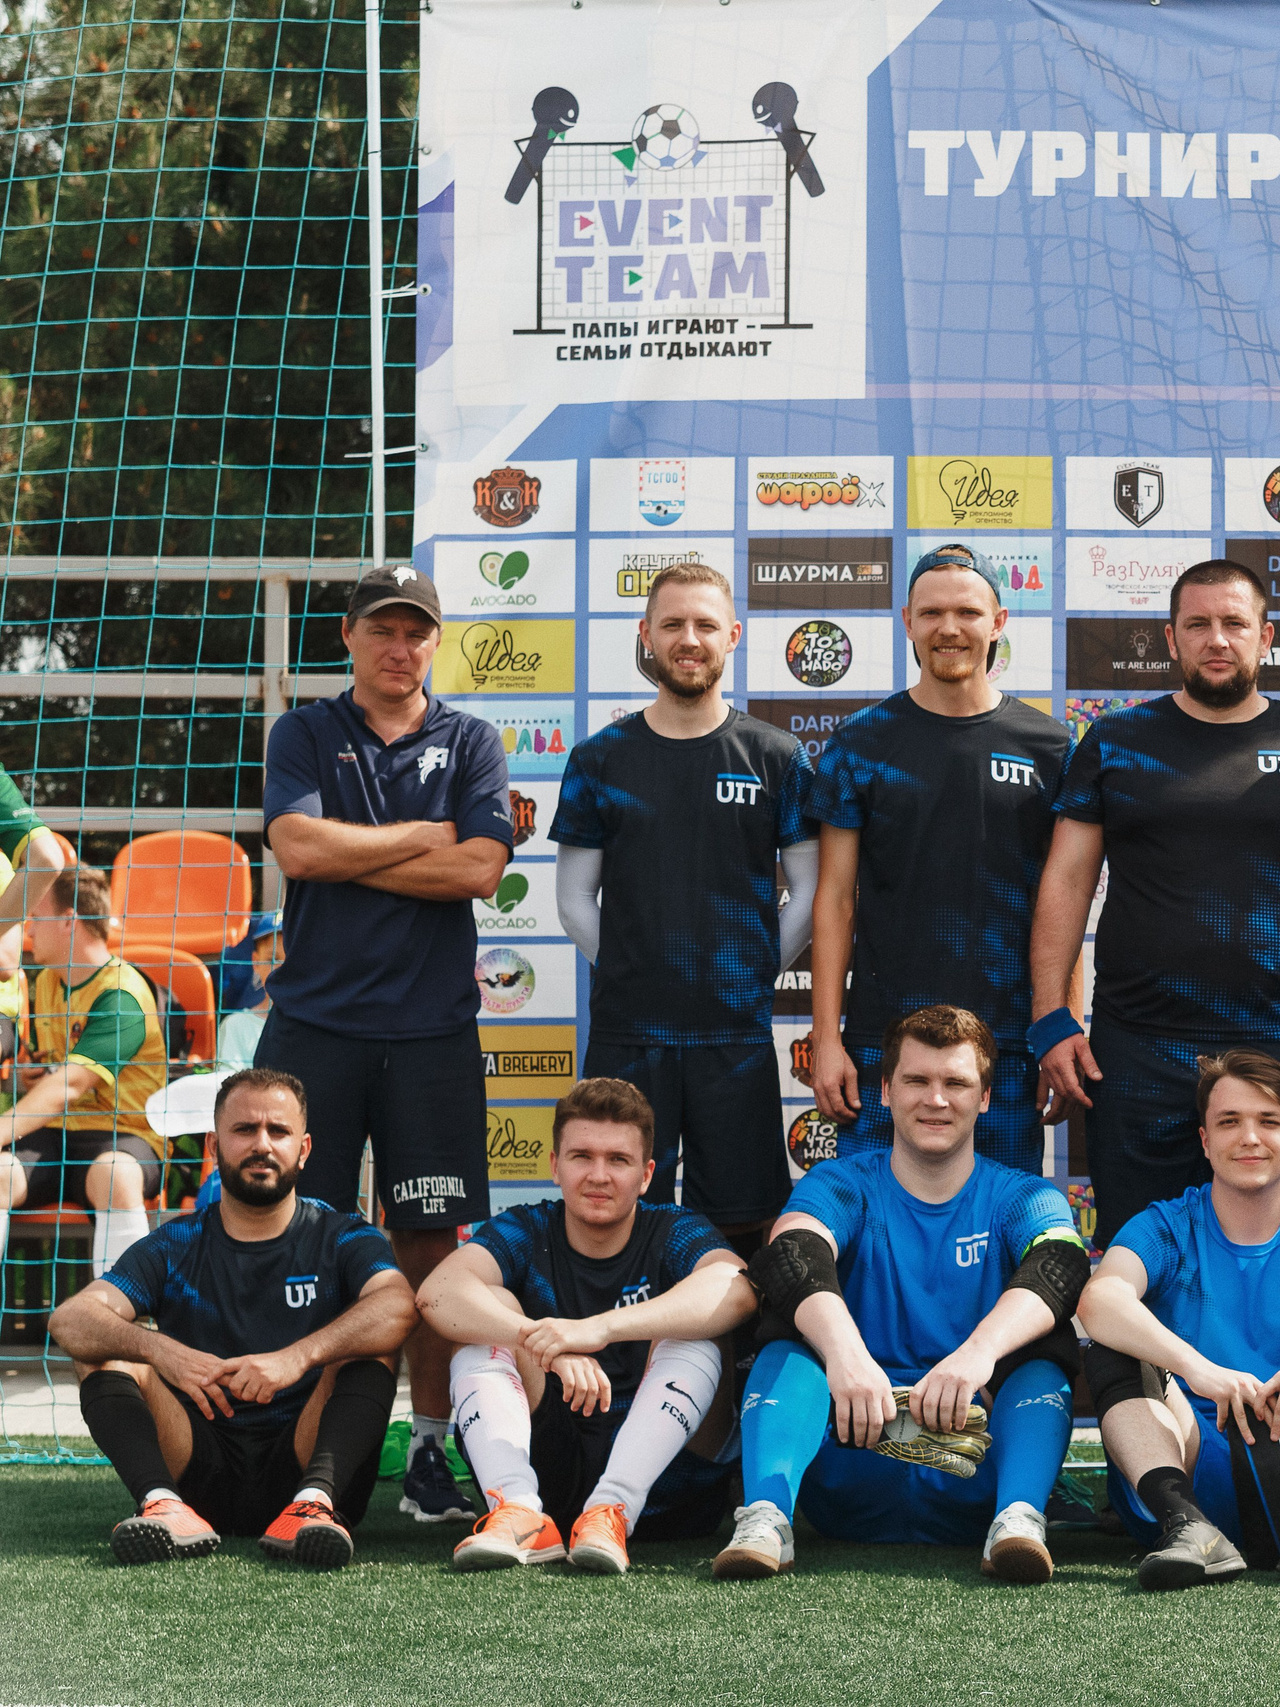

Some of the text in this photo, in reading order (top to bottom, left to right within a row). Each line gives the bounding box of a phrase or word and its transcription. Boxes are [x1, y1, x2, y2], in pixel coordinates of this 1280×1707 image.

[558, 195, 774, 246] EVENT
[555, 252, 770, 302] TEAM
[572, 320, 638, 339] ПАПЫ
[647, 318, 739, 336] ИГРАЮТ
[556, 341, 772, 361] СЕМЬИ ОТДЫХАЮТ
[758, 565, 854, 582] ШАУРМА
[471, 594, 537, 606] AVOCADO
[805, 634, 833, 649] ТО
[802, 661, 842, 672] НАДО
[1146, 662, 1171, 670] LIGHT
[991, 760, 1034, 786] UIT
[717, 781, 761, 805] UIT
[475, 918, 537, 929] VOCADO
[503, 1056, 566, 1073] BREWERY
[807, 1122, 834, 1136] ТО
[804, 1149, 837, 1160] НАД
[393, 1176, 466, 1204] CALIFORNIA
[422, 1198, 446, 1214] LIFE
[661, 1401, 691, 1435] FCSM
